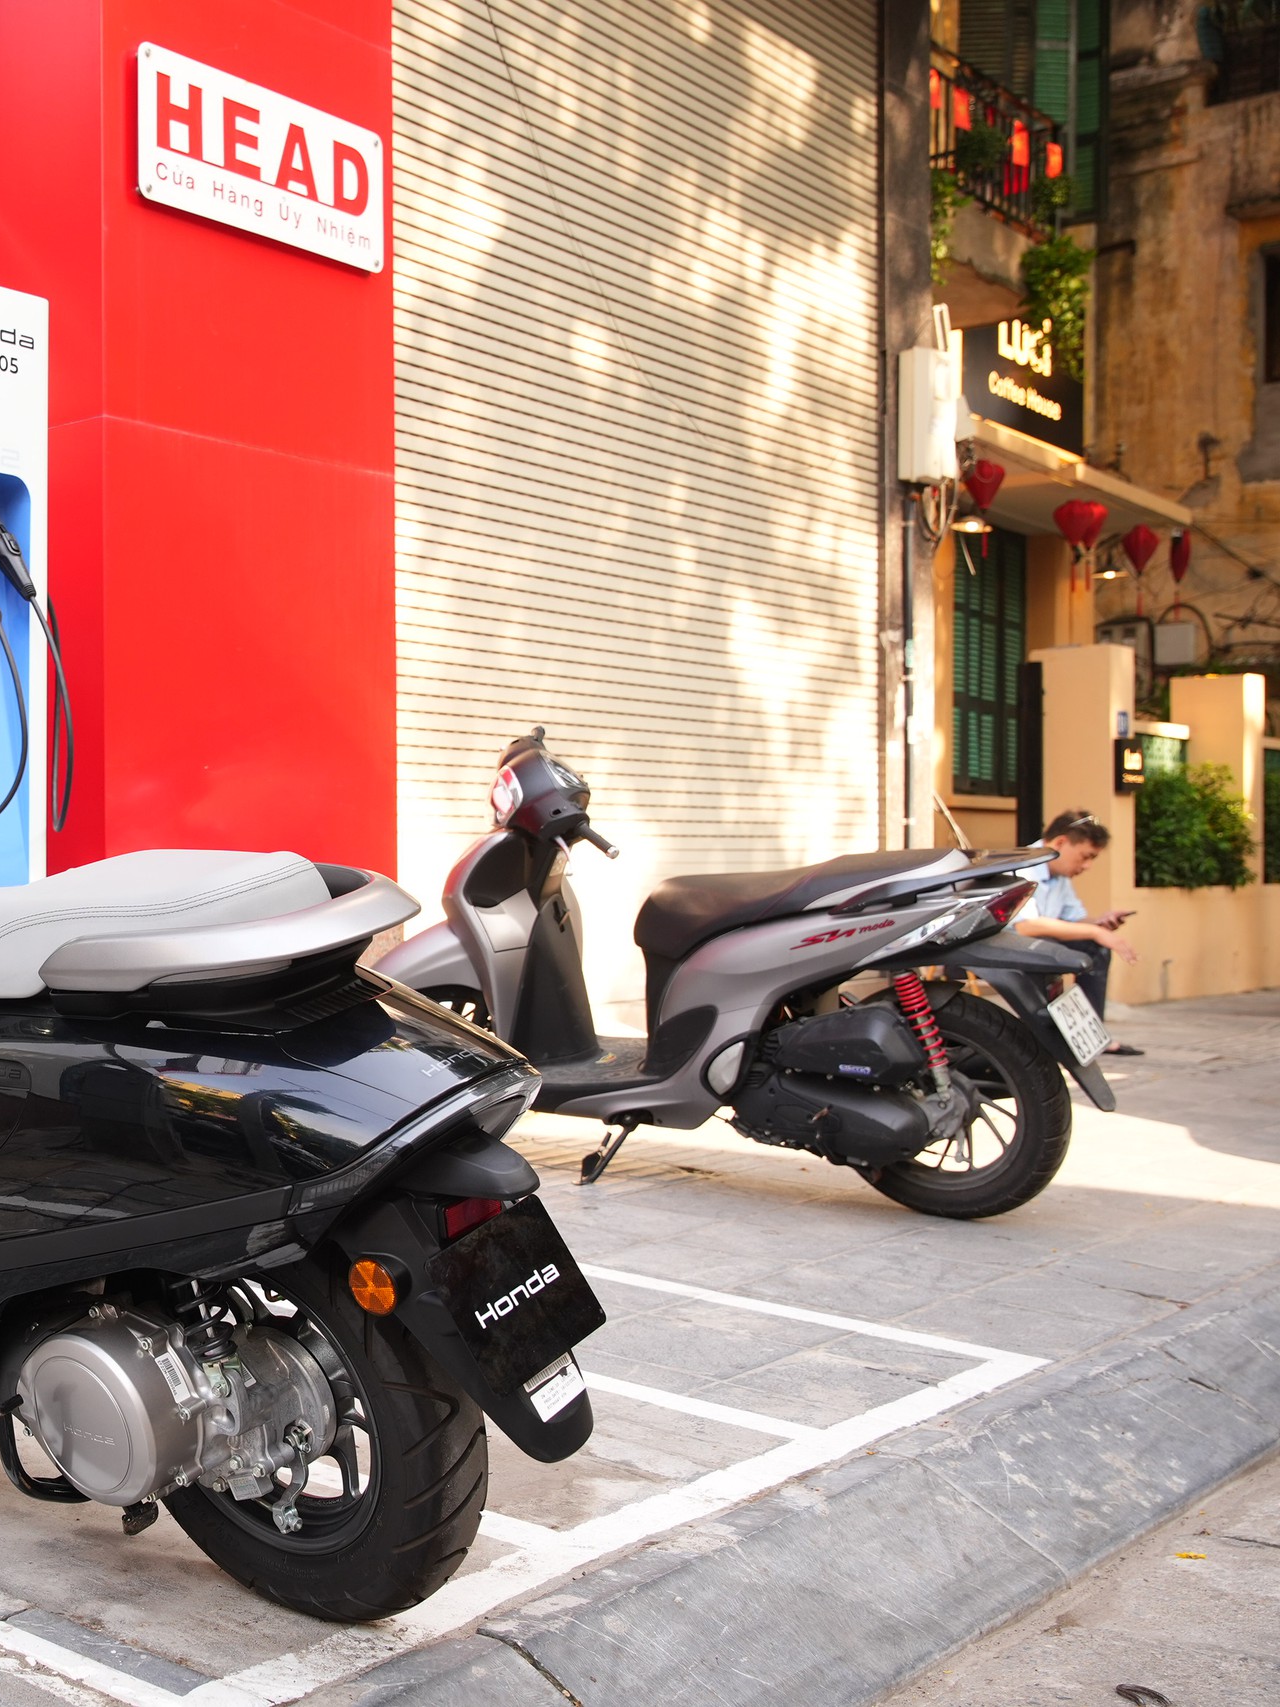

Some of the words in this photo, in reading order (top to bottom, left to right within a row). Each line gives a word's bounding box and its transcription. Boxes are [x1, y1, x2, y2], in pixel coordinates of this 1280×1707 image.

[157, 71, 369, 217] HEAD
[155, 161, 195, 191] Cửa
[213, 180, 264, 217] Hàng
[279, 197, 303, 228] Ủy
[317, 215, 371, 250] Nhiệm
[858, 919, 895, 934] mode
[421, 1046, 483, 1077] Honda
[475, 1263, 560, 1330] Honda
